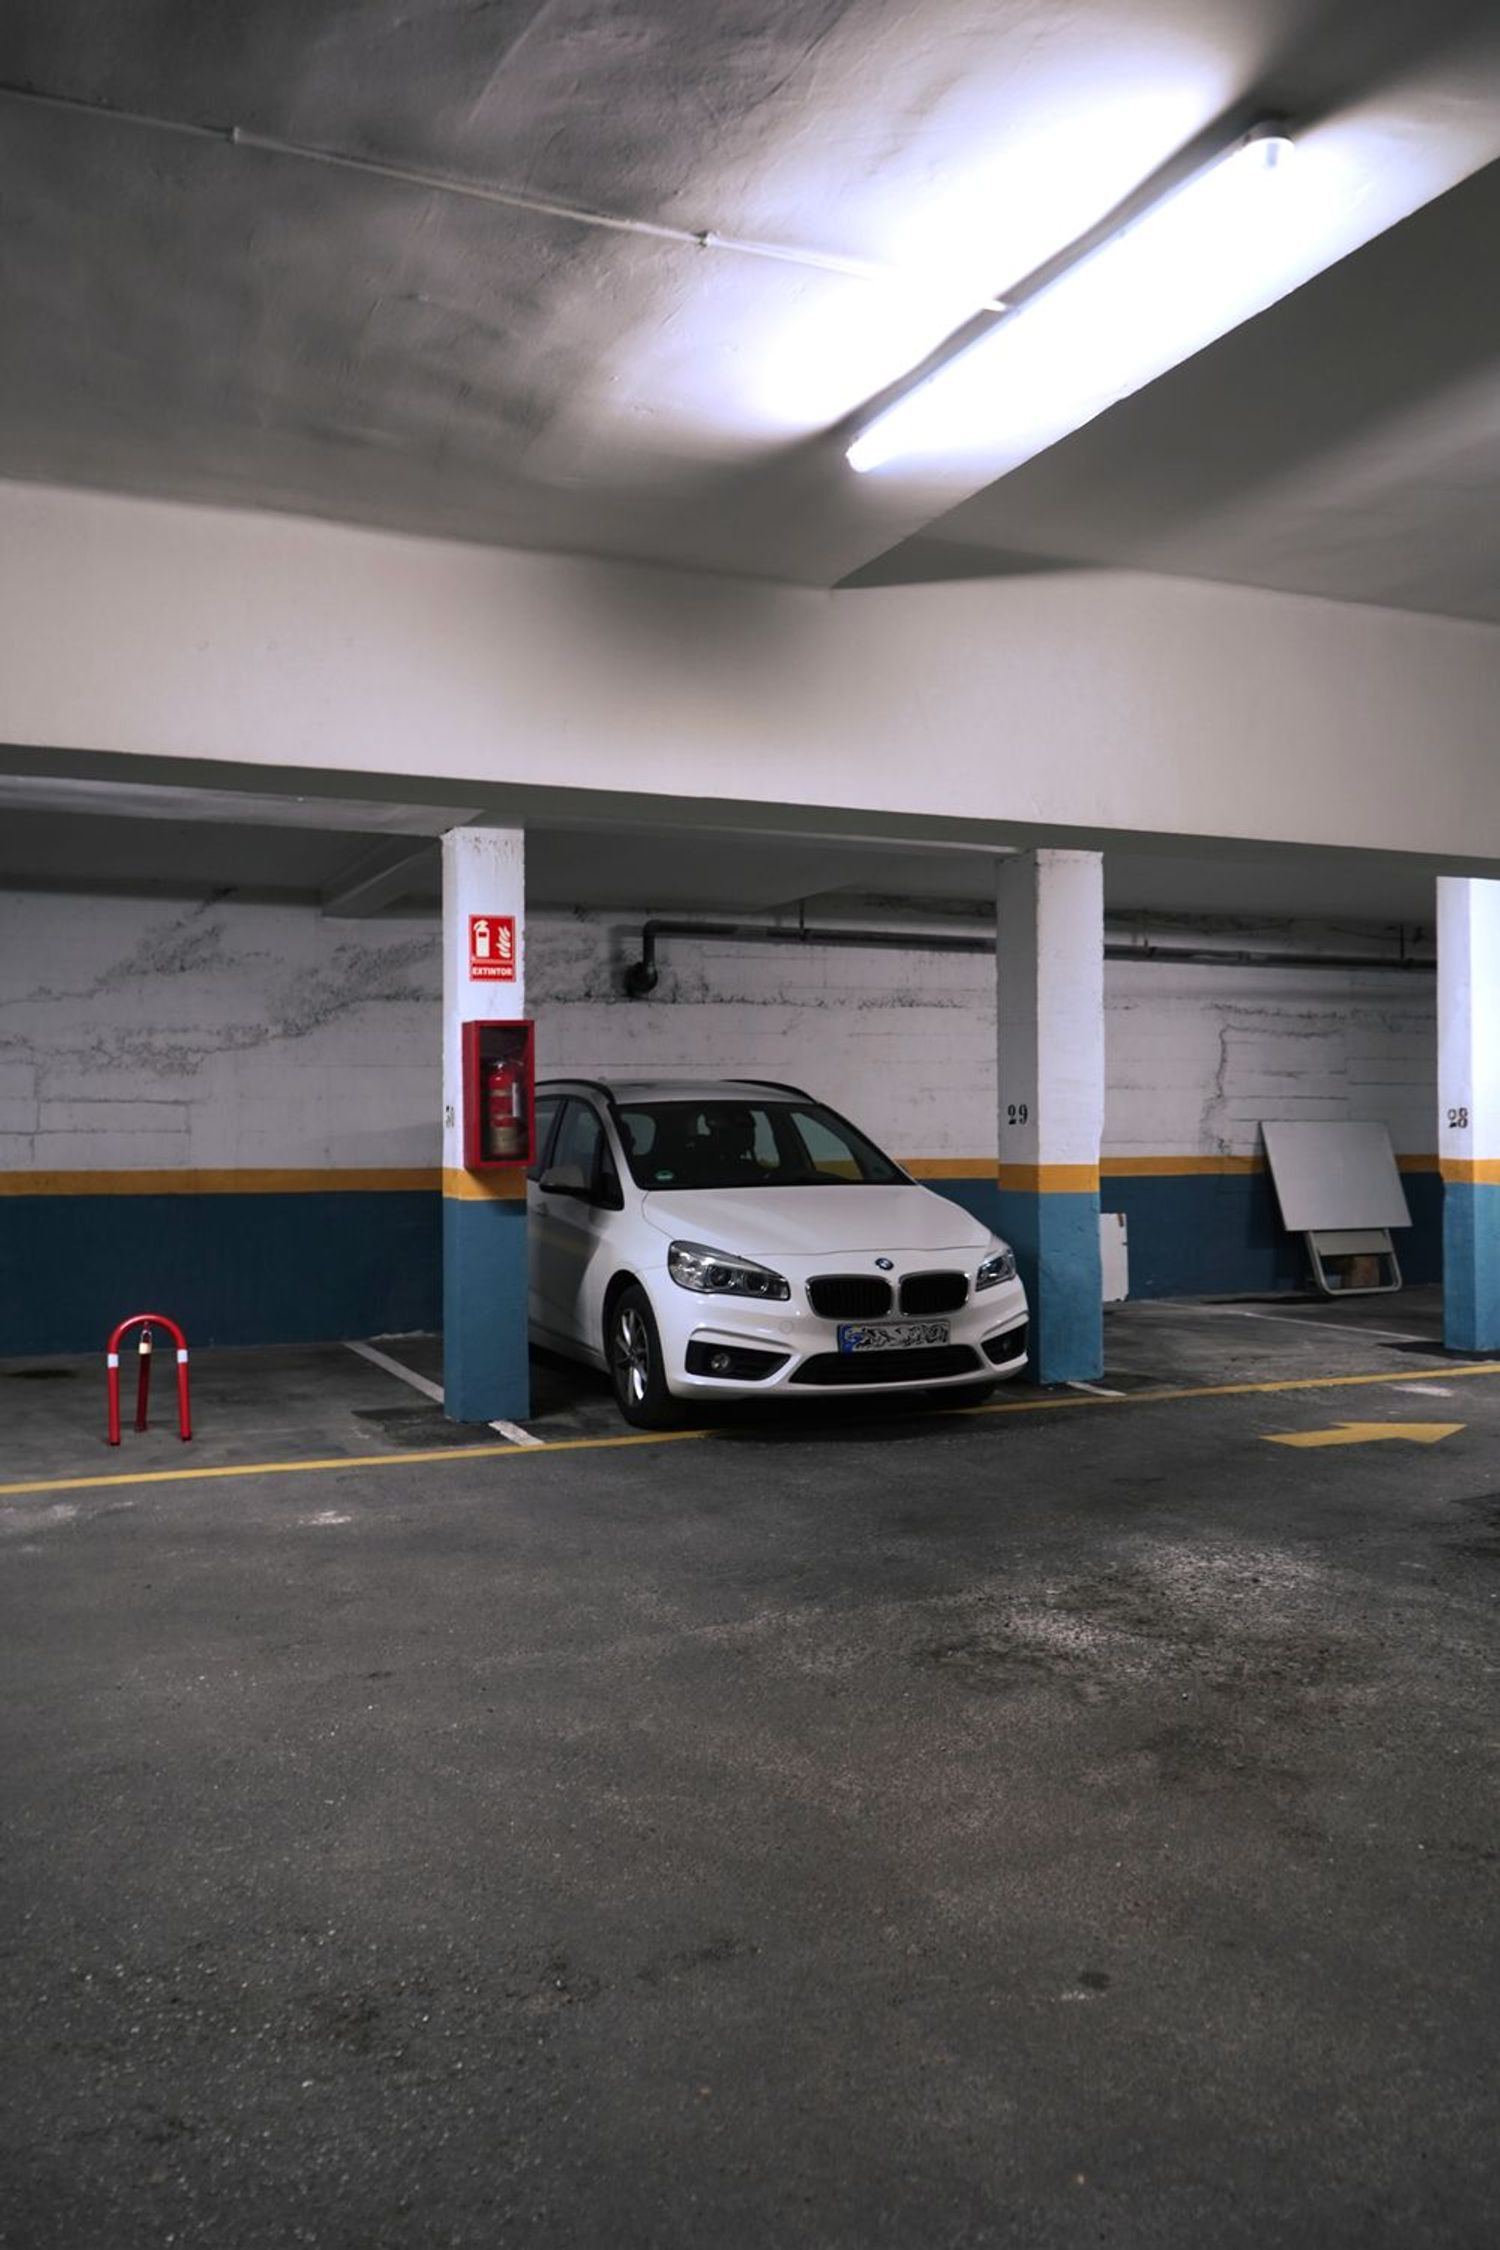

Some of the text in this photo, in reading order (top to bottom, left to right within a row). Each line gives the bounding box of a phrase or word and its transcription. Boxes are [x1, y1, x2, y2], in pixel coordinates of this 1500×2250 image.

[472, 967, 512, 976] EXTINTOR
[1008, 1104, 1028, 1125] 29
[1448, 1107, 1468, 1128] 28
